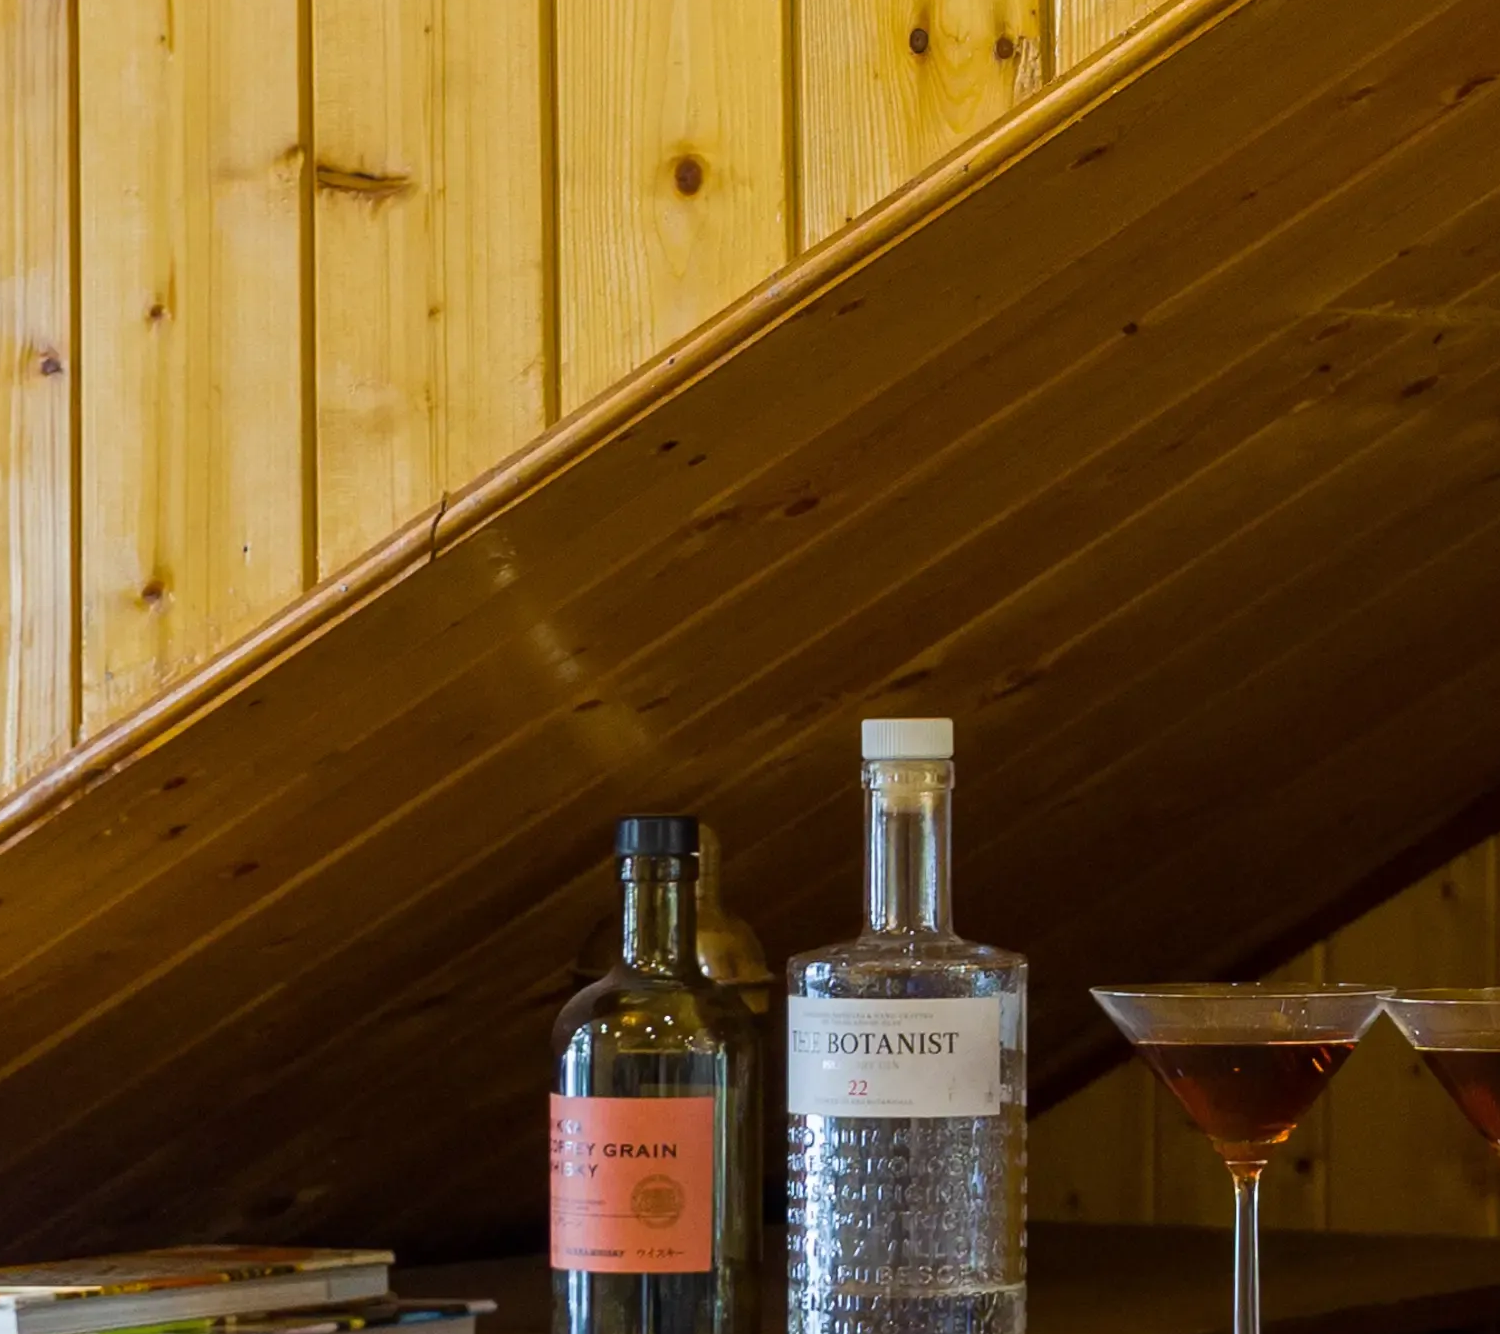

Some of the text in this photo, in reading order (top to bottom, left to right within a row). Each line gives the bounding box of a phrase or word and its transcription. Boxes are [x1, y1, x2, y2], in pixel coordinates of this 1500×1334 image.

[827, 1032, 960, 1055] BOTANIST
[848, 1079, 868, 1096] 22
[603, 1143, 677, 1159] GRAIN
[551, 1160, 598, 1178] HISKY
